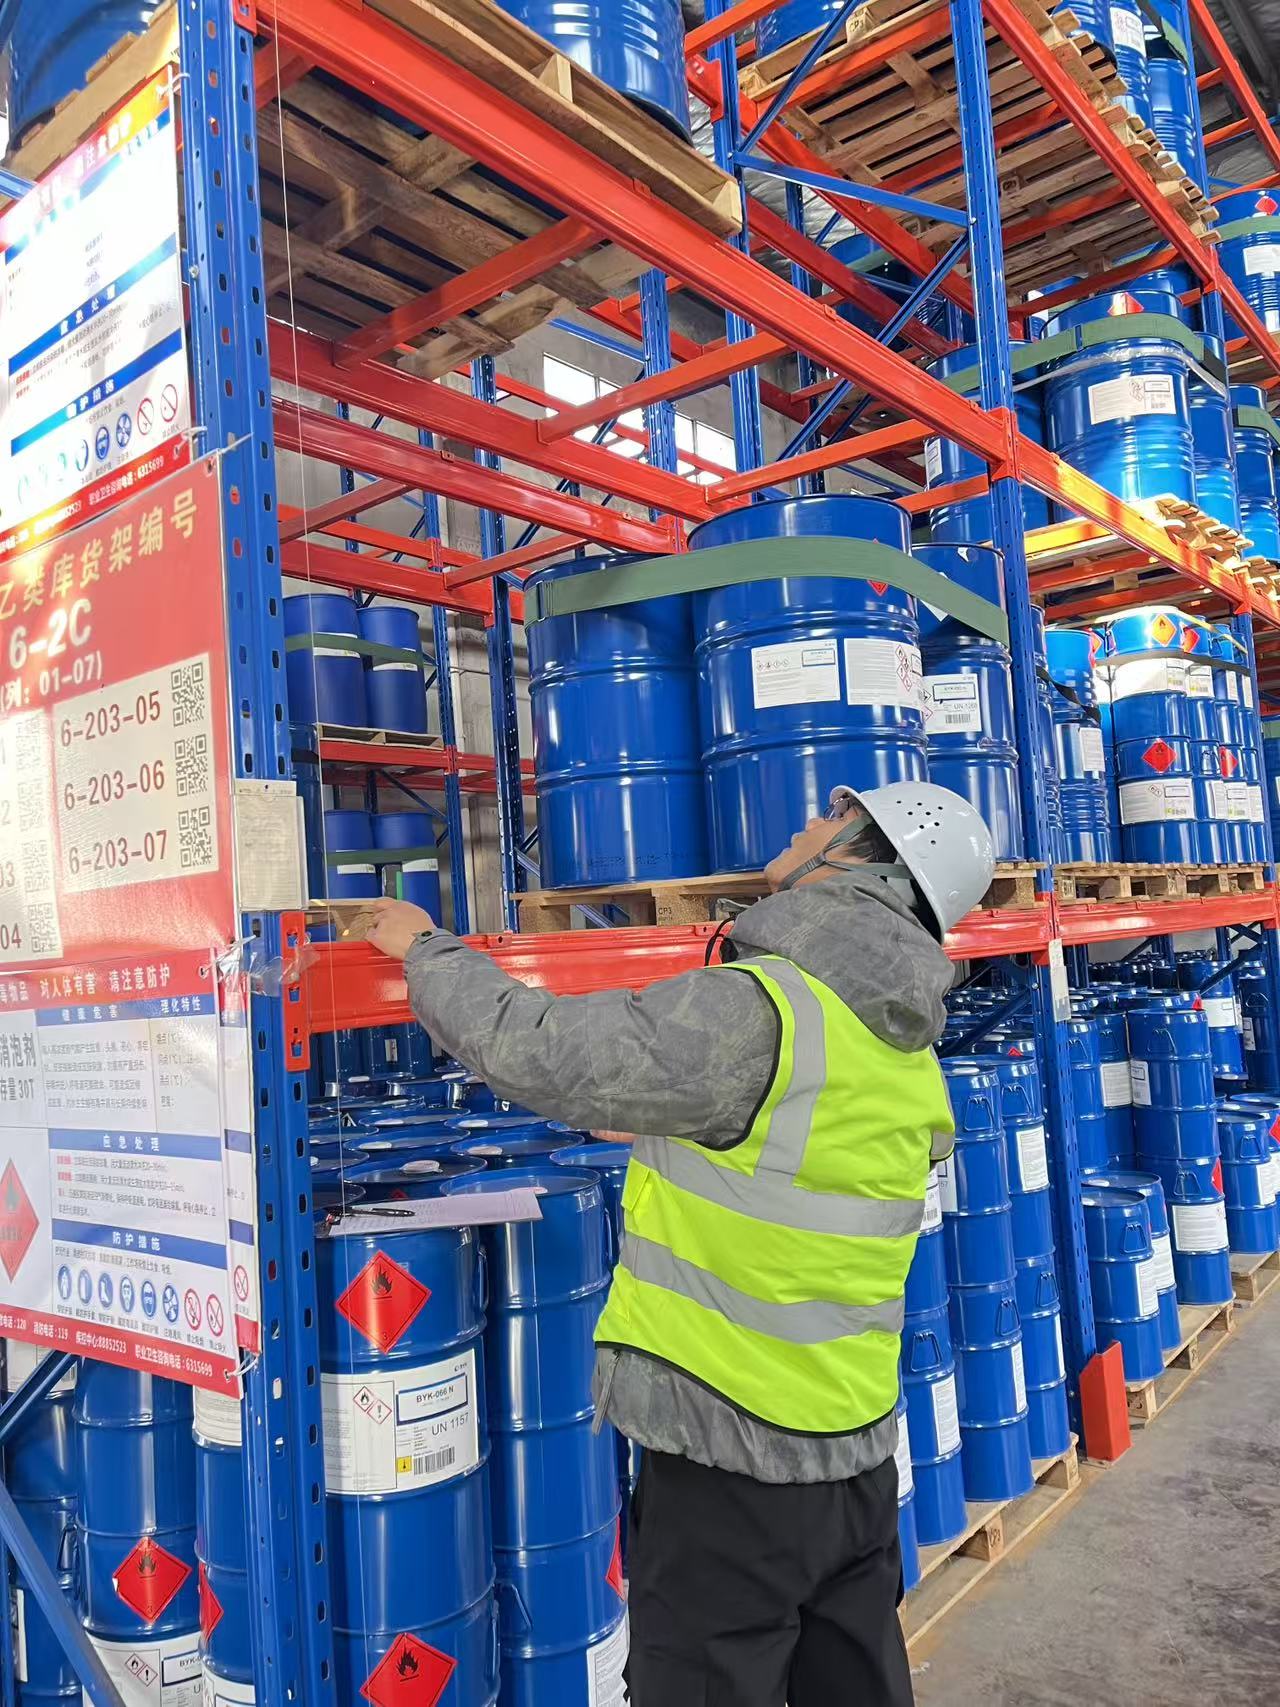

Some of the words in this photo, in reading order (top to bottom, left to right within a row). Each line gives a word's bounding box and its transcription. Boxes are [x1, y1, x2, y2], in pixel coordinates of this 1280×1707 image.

[9, 598, 91, 669] 6-2C
[61, 690, 161, 747] 6-203-05
[64, 759, 165, 811] 6-203-06
[69, 829, 167, 875] 6-203-07
[40, 972, 97, 998] 对人体有害
[109, 963, 170, 993] 请注意防护
[416, 1387, 448, 1403] BYK-066
[431, 1421, 447, 1436] UN
[450, 1412, 469, 1428] 1157
